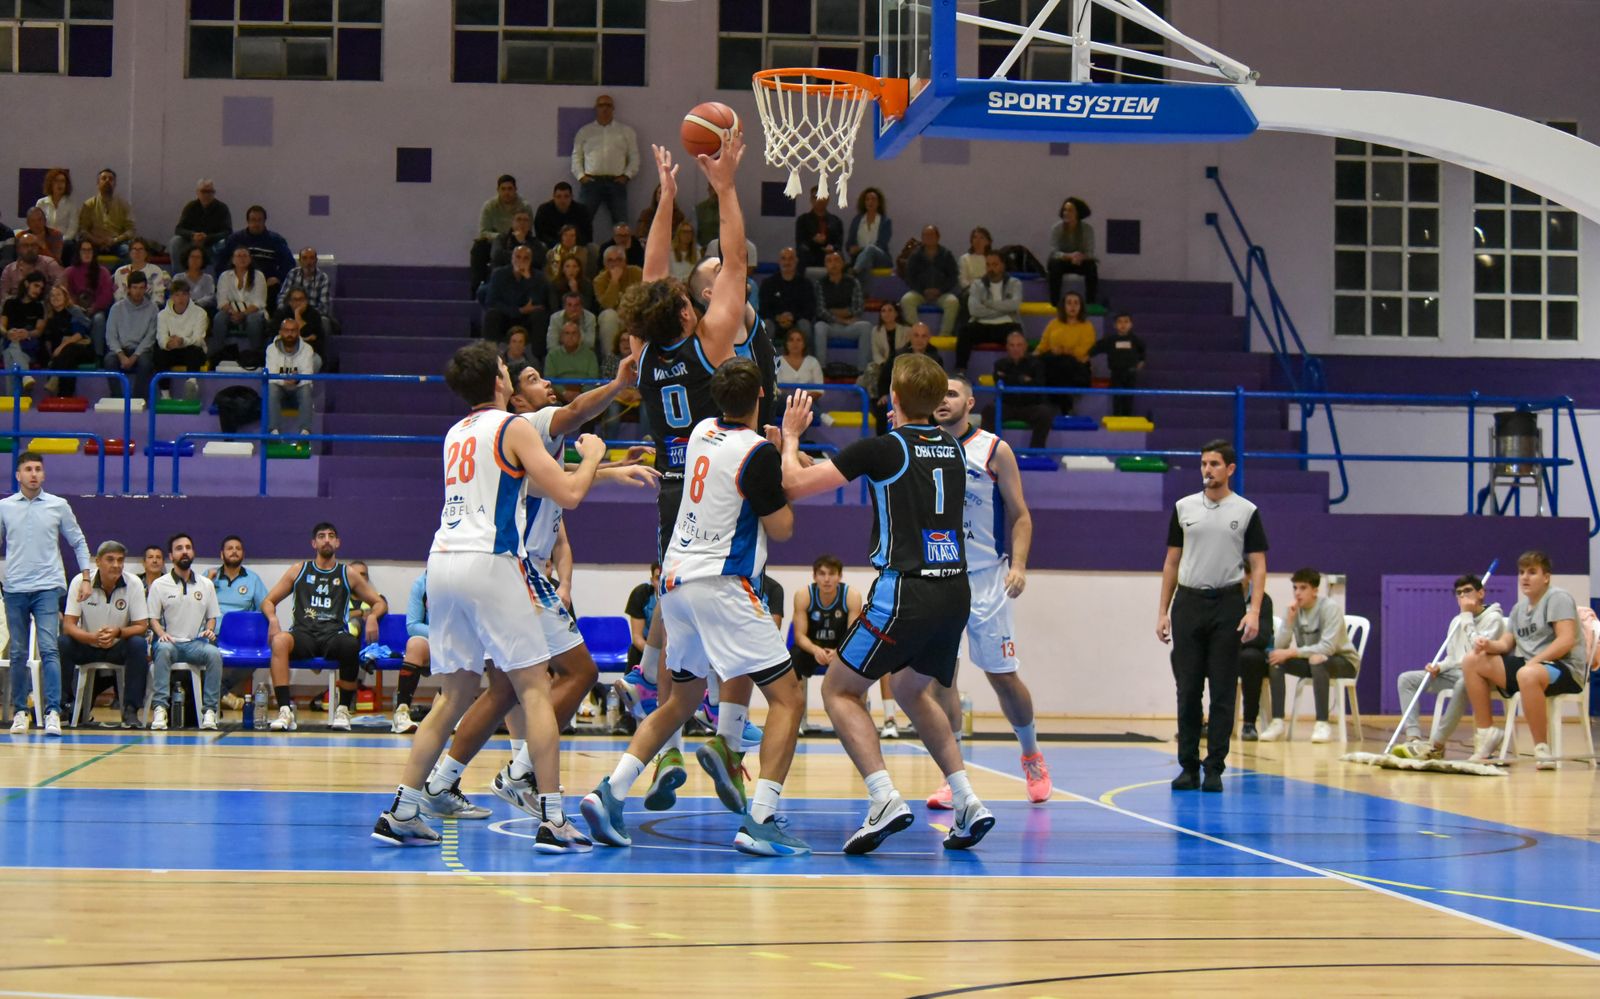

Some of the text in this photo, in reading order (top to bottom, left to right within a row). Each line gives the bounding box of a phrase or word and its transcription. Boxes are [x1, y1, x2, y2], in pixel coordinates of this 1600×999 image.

[988, 91, 1160, 118] SPORT SYSTEM
[653, 361, 688, 381] VALOR
[660, 384, 692, 429] 0
[446, 436, 477, 487] 28
[690, 455, 710, 504] 8
[932, 467, 945, 515] 1
[311, 595, 331, 608] ULB
[315, 584, 329, 595] 44
[1000, 641, 1015, 658] 13
